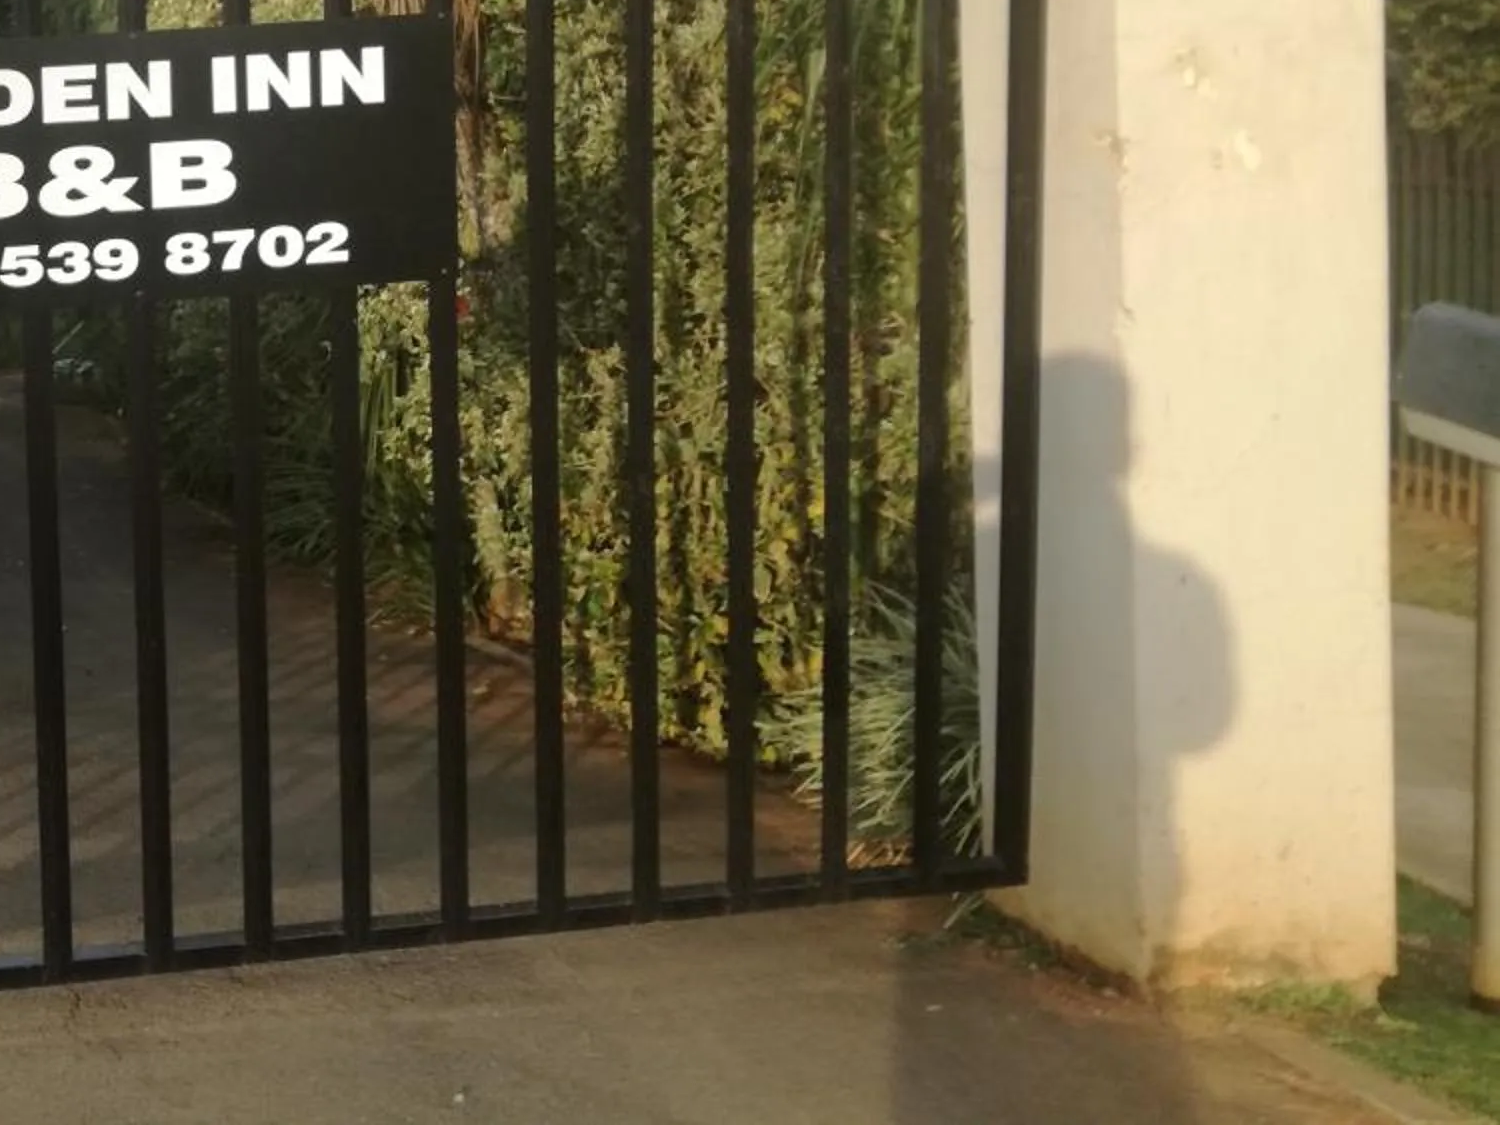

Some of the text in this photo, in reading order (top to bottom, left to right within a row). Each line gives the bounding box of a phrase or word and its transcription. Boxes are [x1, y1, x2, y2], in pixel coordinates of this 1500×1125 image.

[211, 46, 386, 114] INN
[0, 238, 139, 287] 539
[164, 221, 350, 274] 8702
